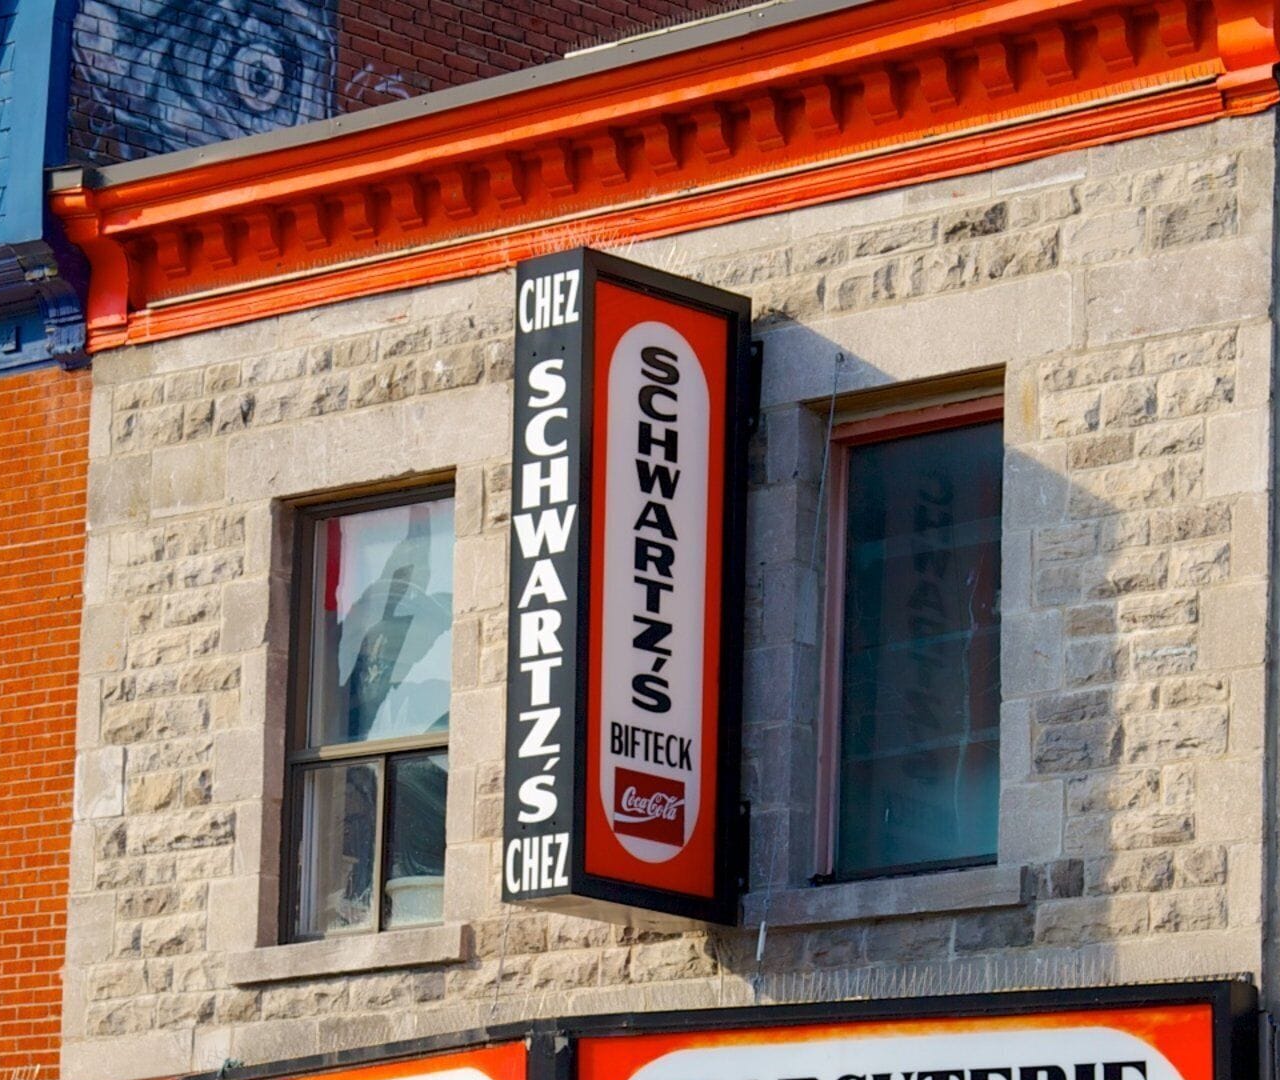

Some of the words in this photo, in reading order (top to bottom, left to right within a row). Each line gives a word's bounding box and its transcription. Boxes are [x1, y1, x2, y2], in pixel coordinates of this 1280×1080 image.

[519, 269, 580, 334] CHEZ
[631, 346, 681, 714] SCHWARTZ'S
[512, 358, 577, 824] SCHWARTZ'S
[610, 721, 692, 771] BIFTECK
[505, 832, 569, 894] CHEZ
